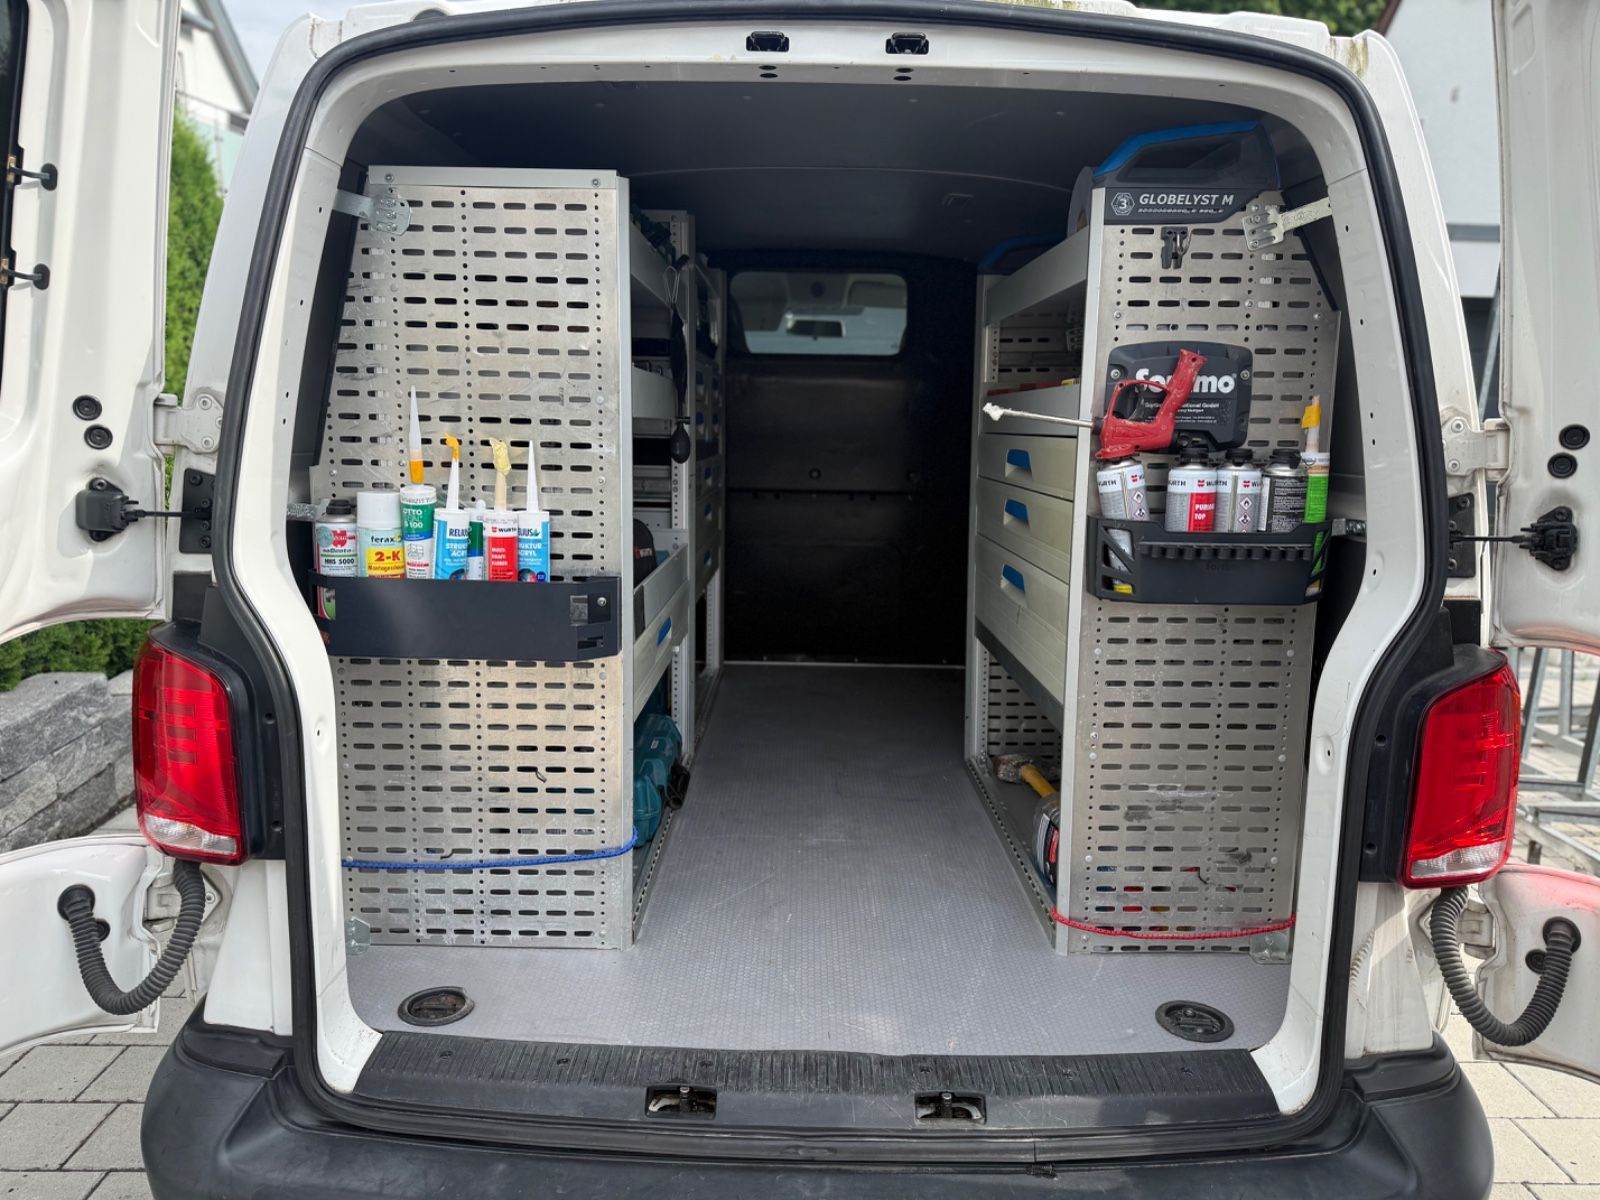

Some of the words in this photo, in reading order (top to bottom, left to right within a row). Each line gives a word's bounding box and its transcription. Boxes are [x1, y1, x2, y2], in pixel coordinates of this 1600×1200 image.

[1139, 193, 1219, 206] GLOBELYST
[1221, 194, 1235, 206] M
[410, 521, 424, 529] 100
[371, 535, 394, 543] ferax
[374, 550, 401, 562] 2-K
